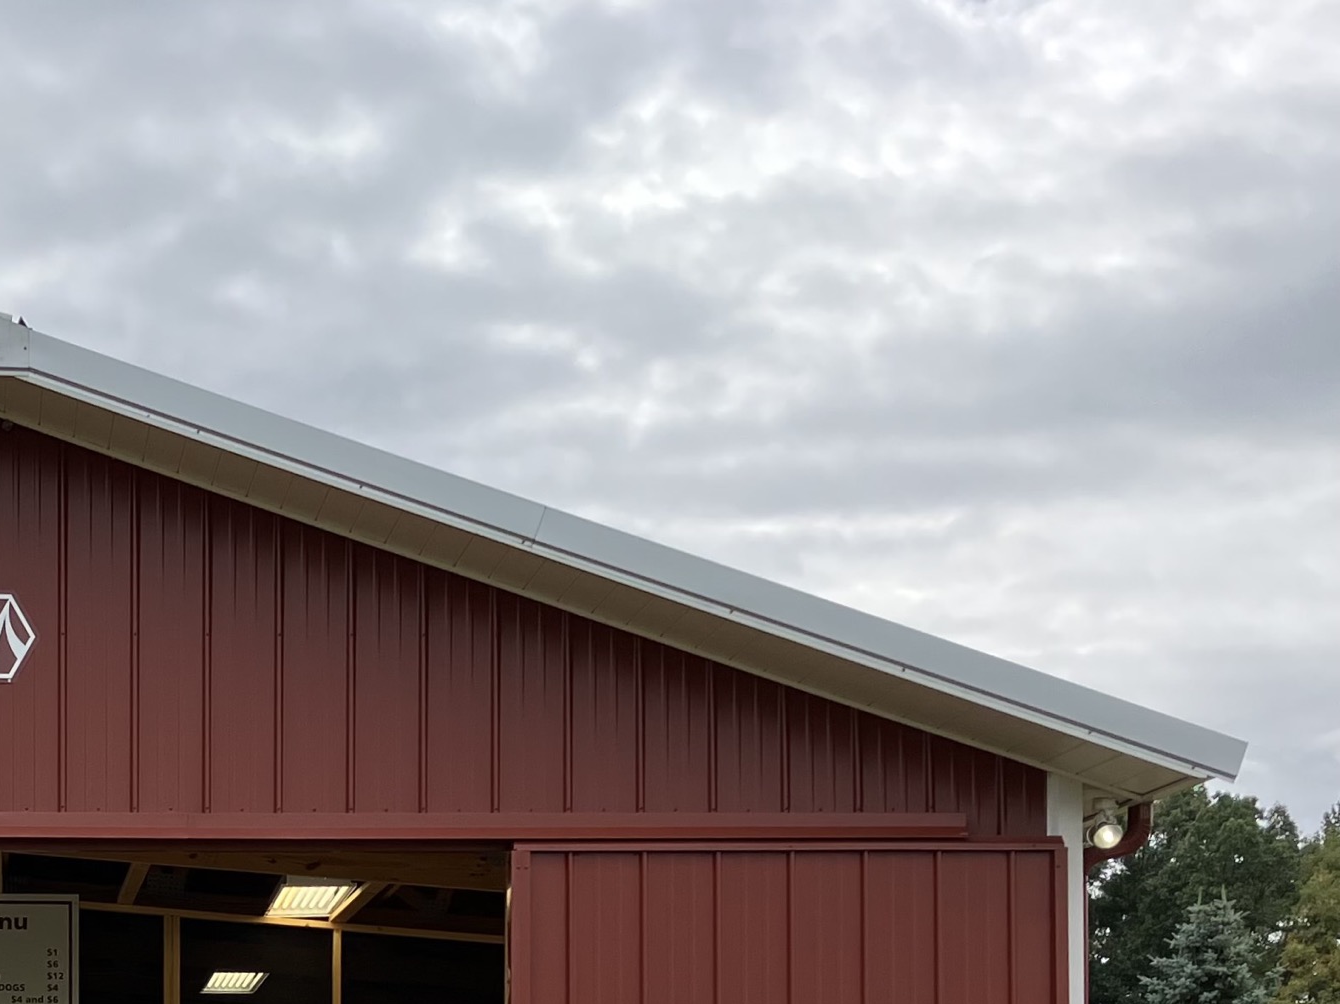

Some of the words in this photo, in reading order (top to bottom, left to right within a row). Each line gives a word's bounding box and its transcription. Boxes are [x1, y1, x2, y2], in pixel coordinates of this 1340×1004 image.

[47, 948, 58, 956] $1
[47, 960, 58, 968] $6
[47, 972, 64, 980] $12
[47, 984, 58, 992] $4
